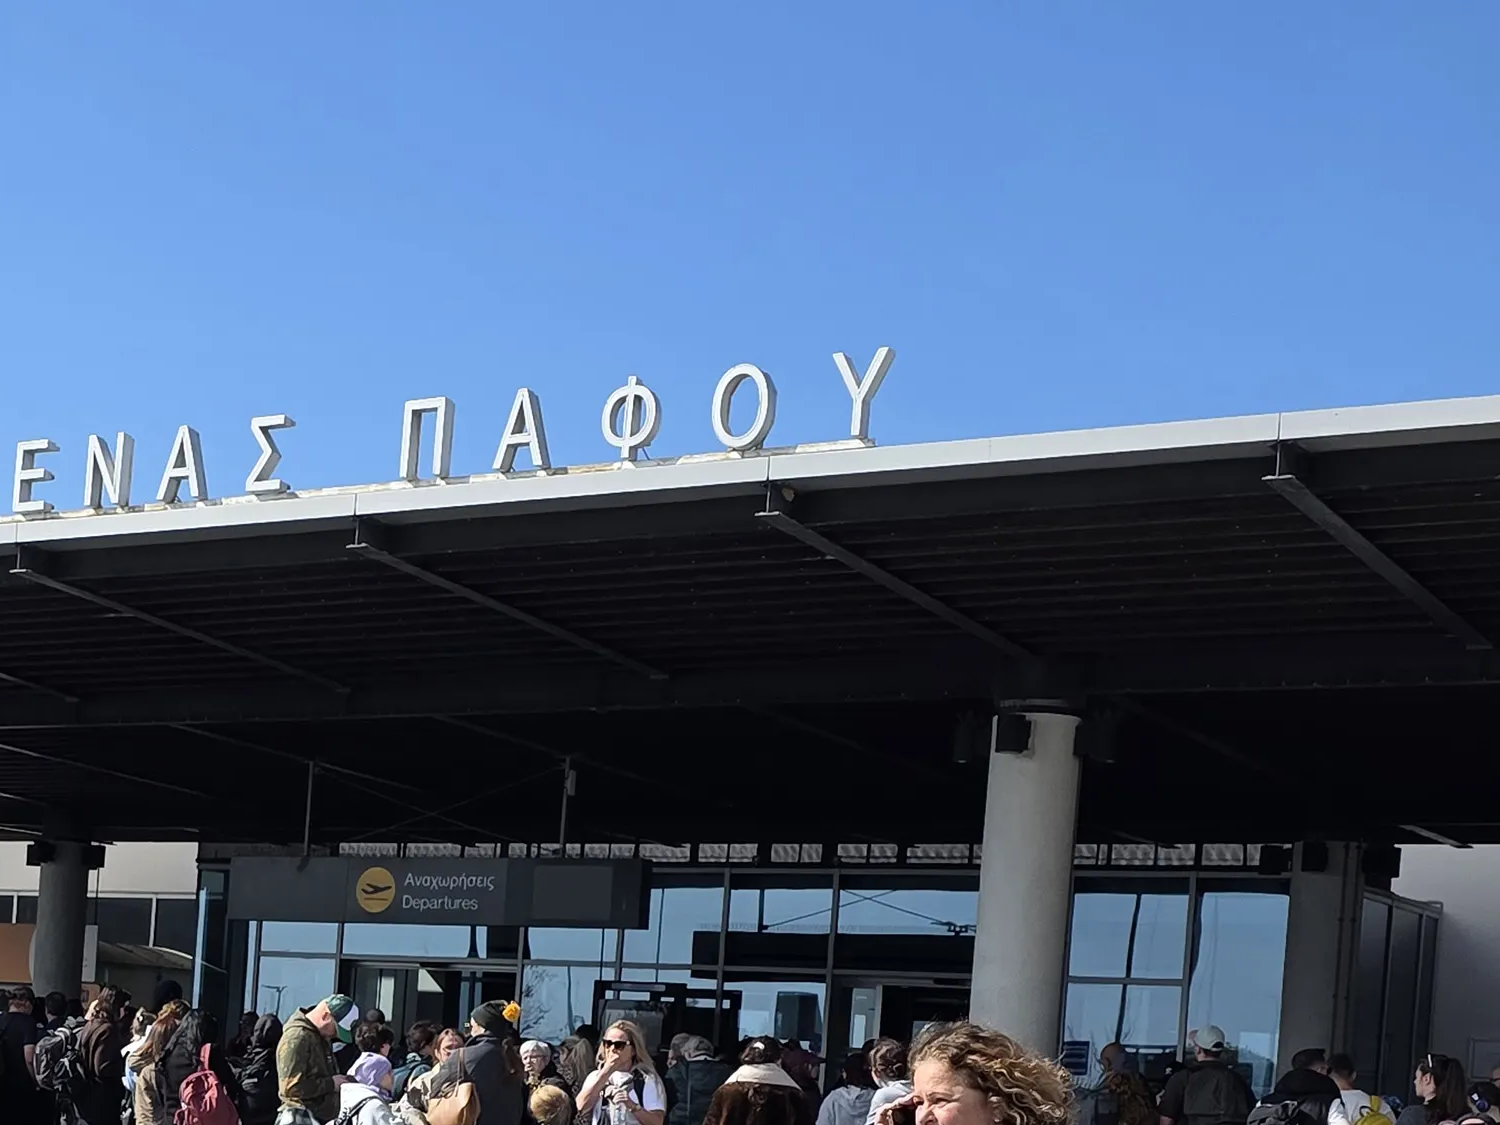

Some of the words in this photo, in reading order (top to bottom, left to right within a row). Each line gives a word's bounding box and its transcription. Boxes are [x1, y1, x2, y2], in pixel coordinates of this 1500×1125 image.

[399, 346, 896, 483] ΠΑΦΟΥ
[404, 872, 495, 891] Αναχωρήσεις
[402, 894, 478, 912] Departures
